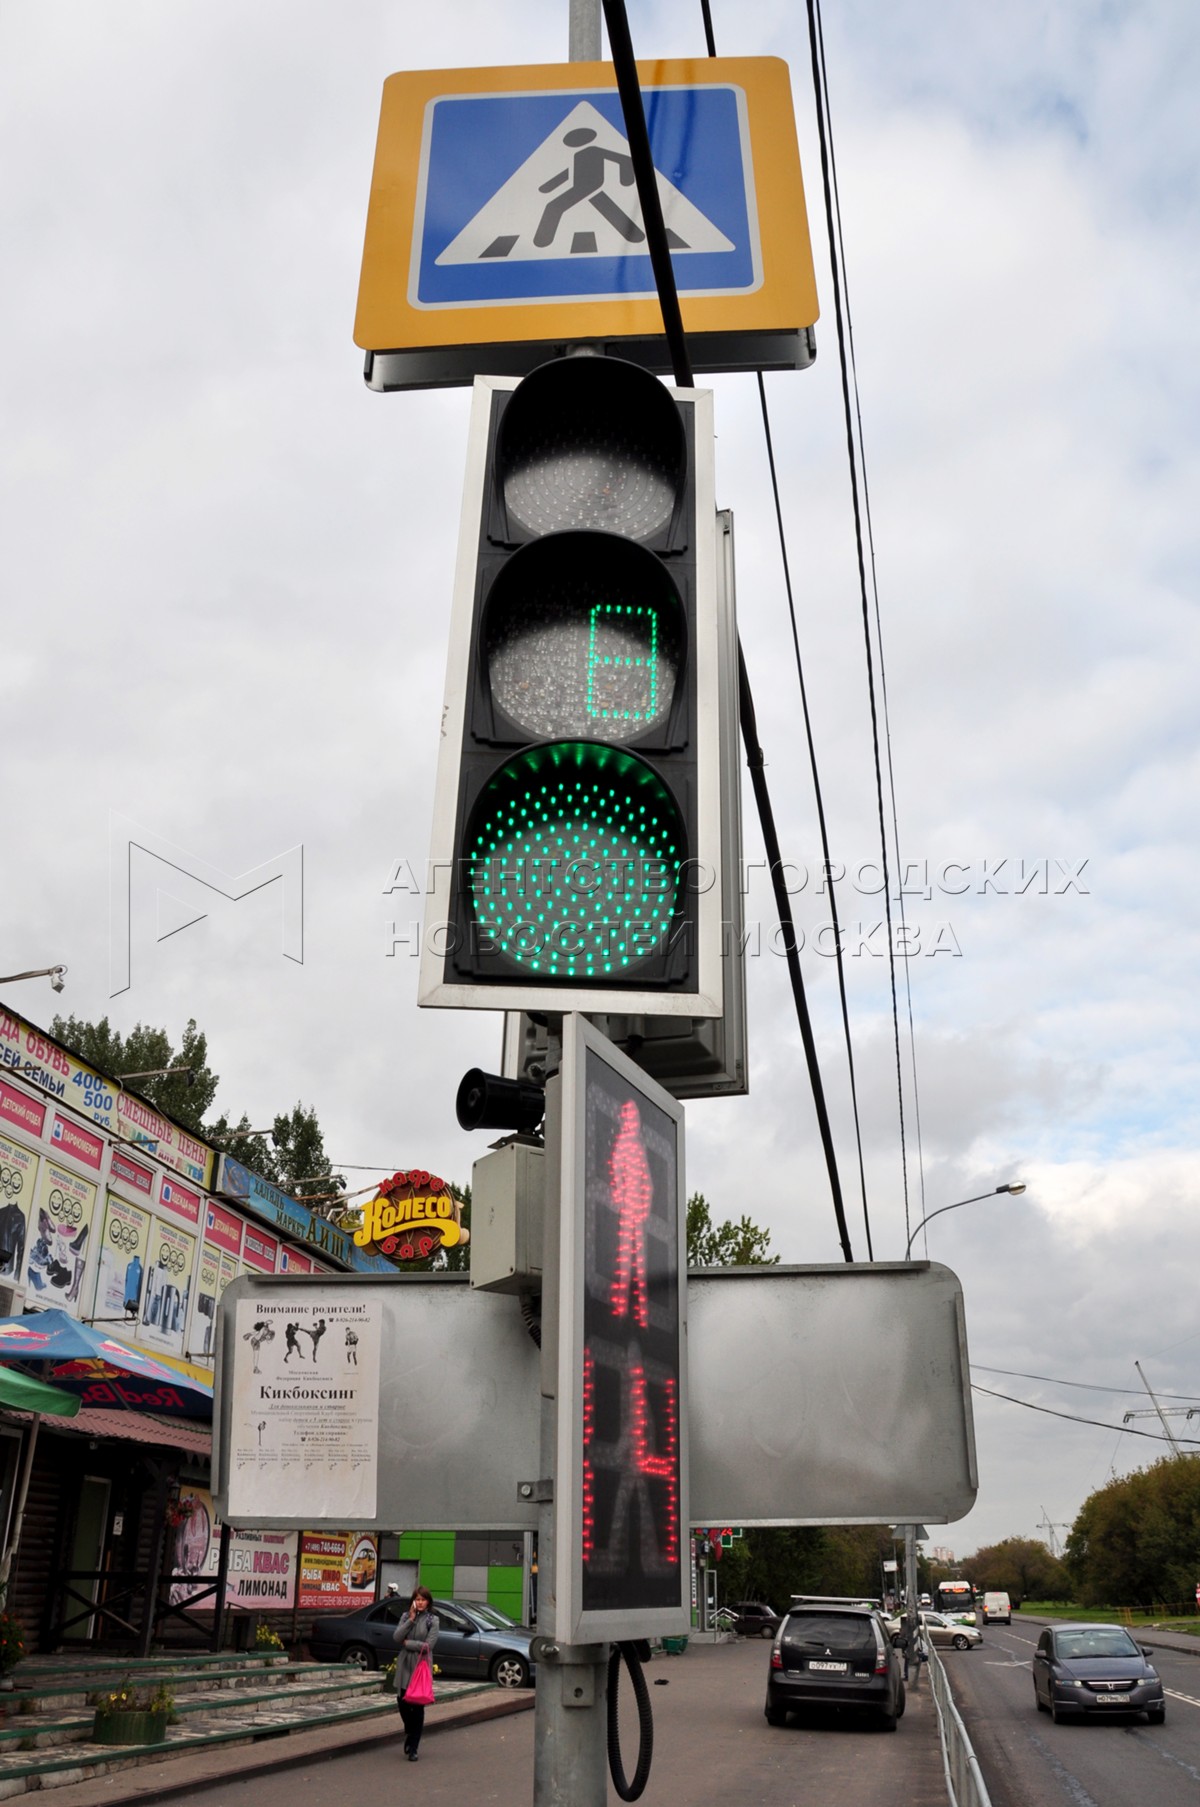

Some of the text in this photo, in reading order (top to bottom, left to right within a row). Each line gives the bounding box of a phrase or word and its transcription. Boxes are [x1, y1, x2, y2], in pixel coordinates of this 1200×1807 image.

[0, 1011, 70, 1077] ДА ОБУВЬ
[24, 1061, 65, 1097] СЕМЬИ
[83, 1089, 113, 1111] 500
[117, 1092, 208, 1168] СМЕШНЫЕ ЦЕНЫ
[381, 1236, 433, 1258] бар
[256, 1304, 366, 1316] Внимание родители!
[260, 1385, 357, 1400] Кикбоксинг
[253, 1551, 289, 1574] КВАС
[302, 1568, 323, 1582] РЫБА
[238, 1580, 287, 1599] ЛИМОНАД
[321, 1582, 341, 1592] КВАС
